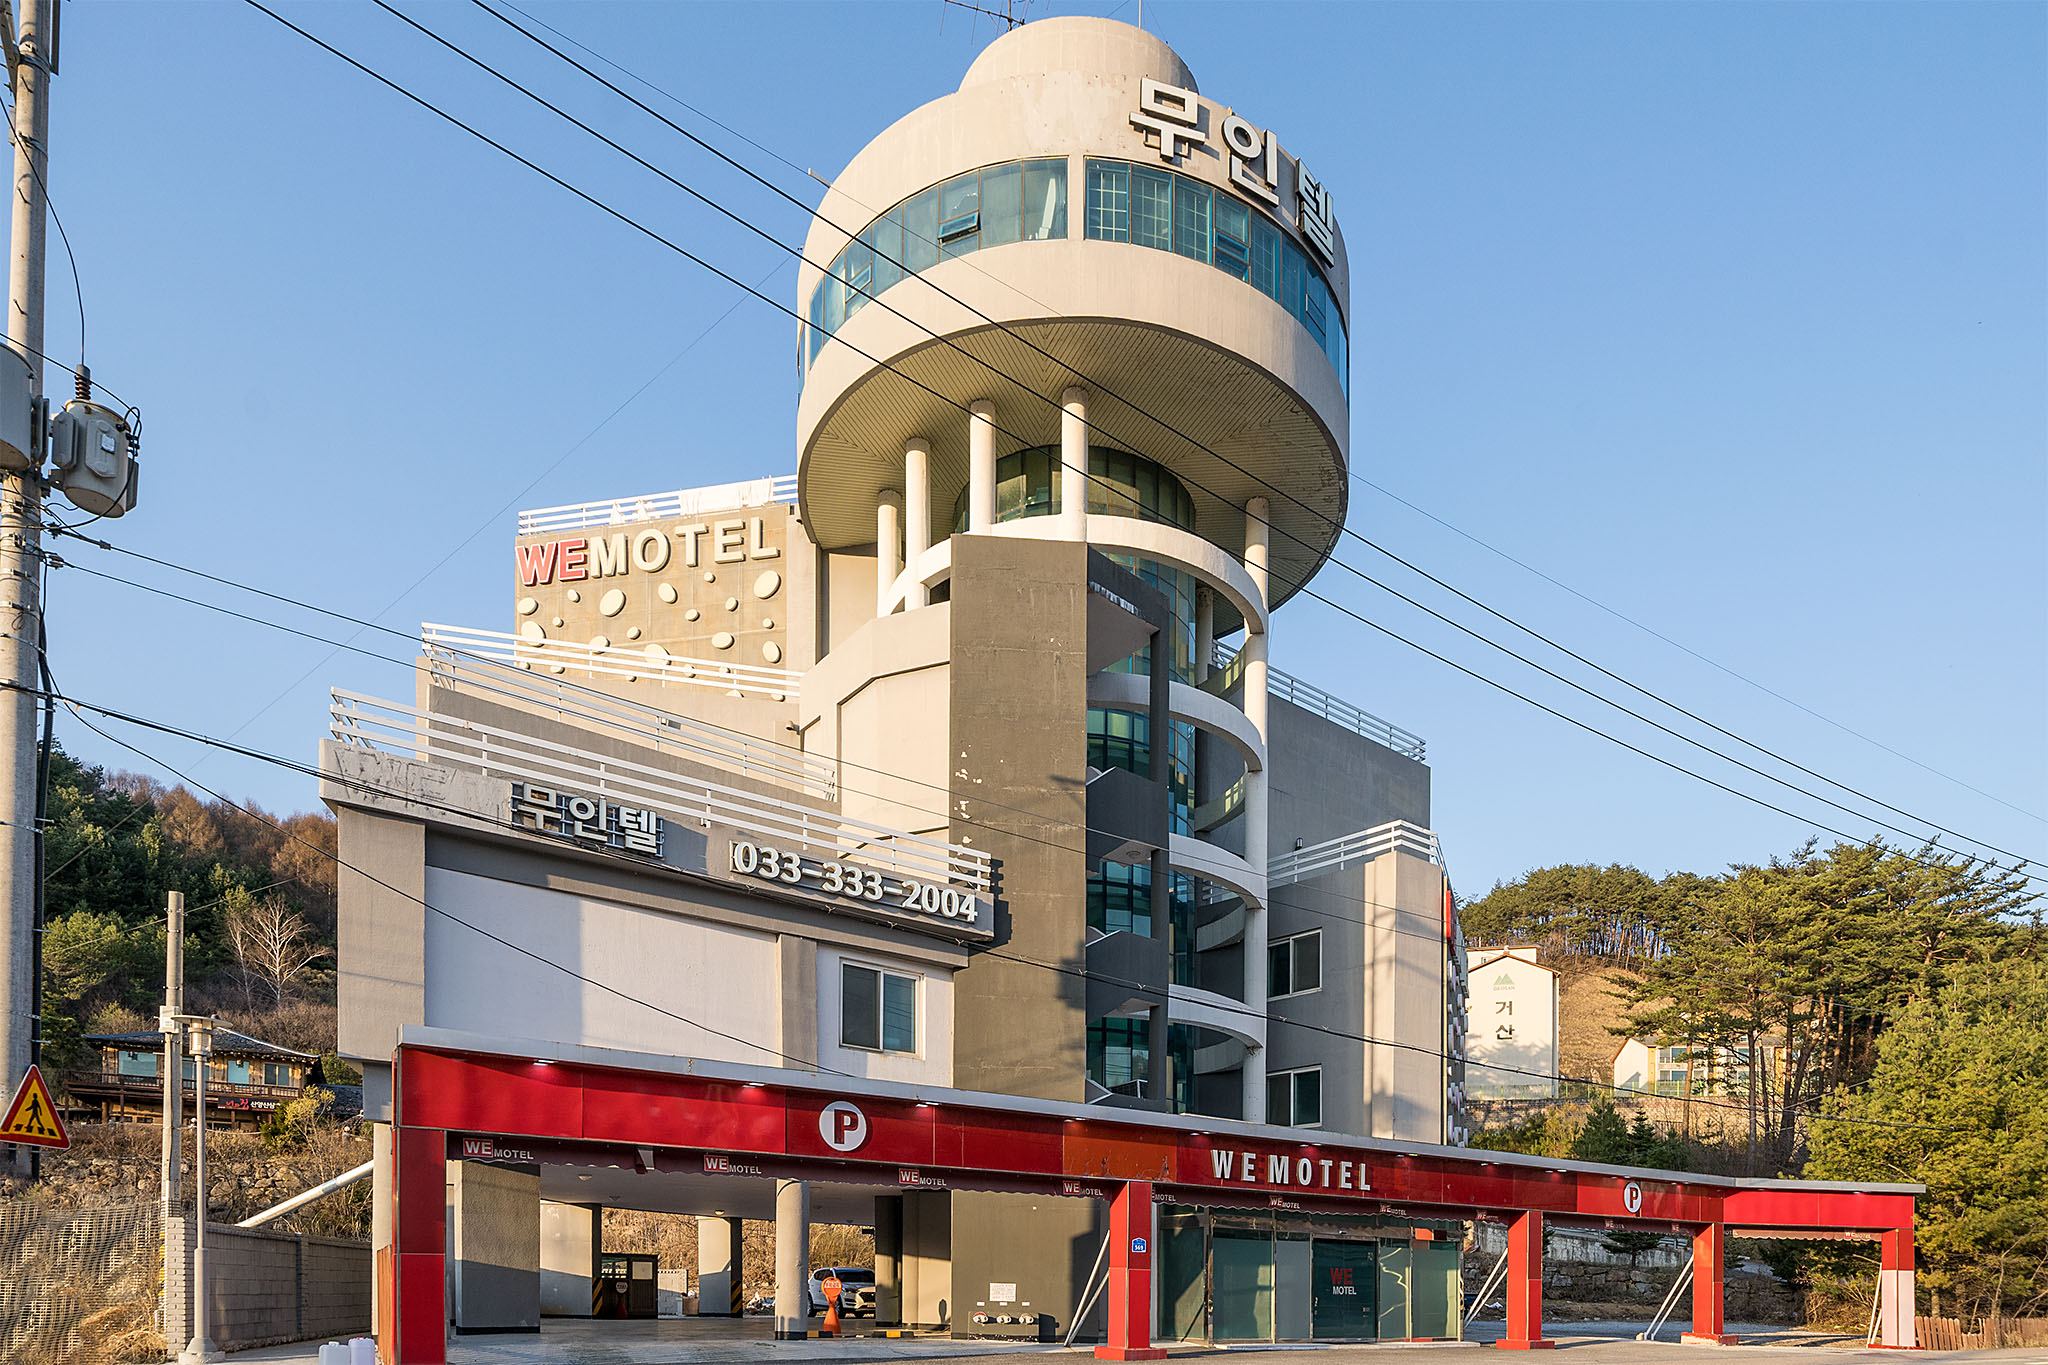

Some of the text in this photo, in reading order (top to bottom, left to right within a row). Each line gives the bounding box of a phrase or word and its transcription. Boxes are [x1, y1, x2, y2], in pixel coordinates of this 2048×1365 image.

[1129, 76, 1335, 268] 무인텔
[517, 782, 658, 854] 무인텔
[734, 842, 978, 923] 033-333-2004
[834, 1108, 859, 1145] P
[465, 1140, 534, 1160] WE MOTEL
[705, 1157, 762, 1174] WE MOTEL
[1210, 1149, 1371, 1191] WE MOTEL
[901, 1170, 947, 1186] WE MOTEL
[1063, 1182, 1103, 1196] WE MOTEL
[1155, 1193, 1176, 1202] MOTEL
[1629, 1186, 1639, 1208] P
[1270, 1198, 1300, 1210] WE MOTEL
[1330, 1267, 1353, 1285] WE
[1332, 1285, 1357, 1295] MOTEL
